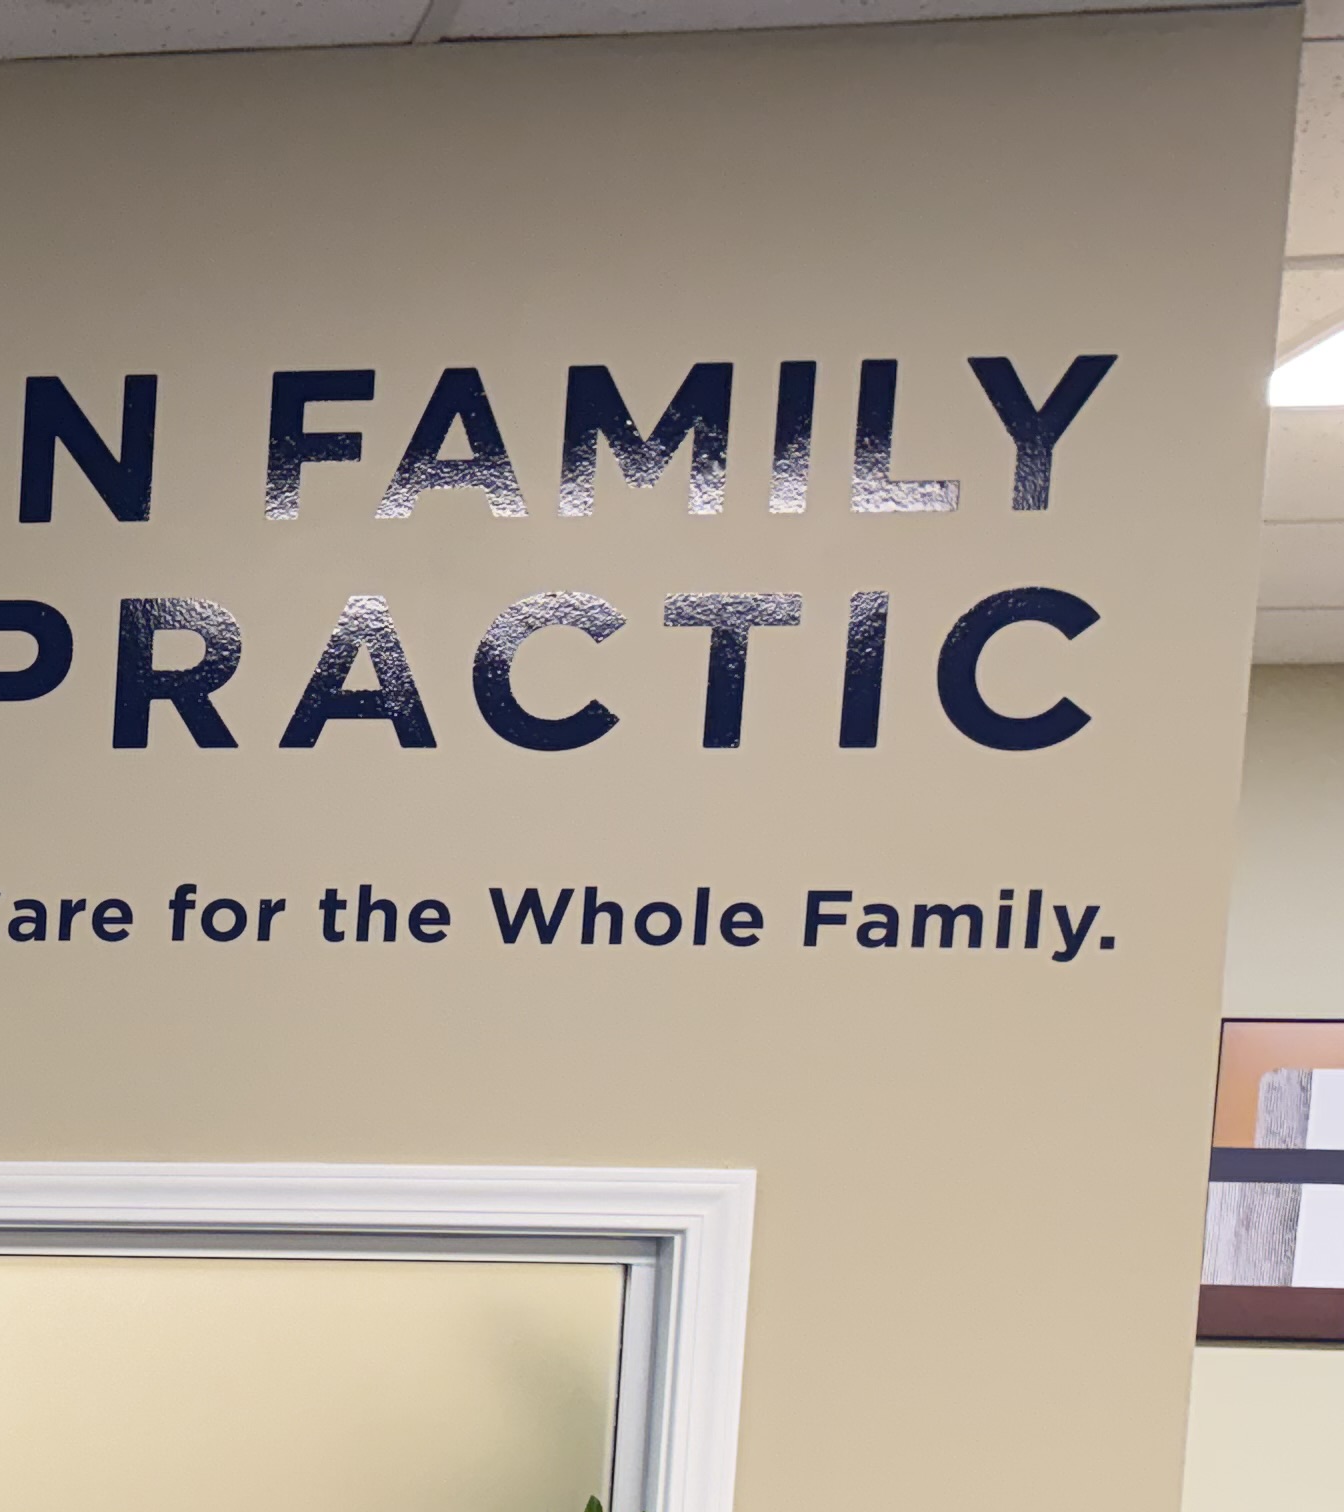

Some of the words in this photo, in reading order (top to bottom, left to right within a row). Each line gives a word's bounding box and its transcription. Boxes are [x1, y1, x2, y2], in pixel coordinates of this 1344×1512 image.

[262, 354, 1118, 520] FAMILY
[168, 883, 286, 942] for
[319, 886, 452, 944] the
[489, 886, 764, 946] Whole
[802, 888, 1116, 963] Family.
